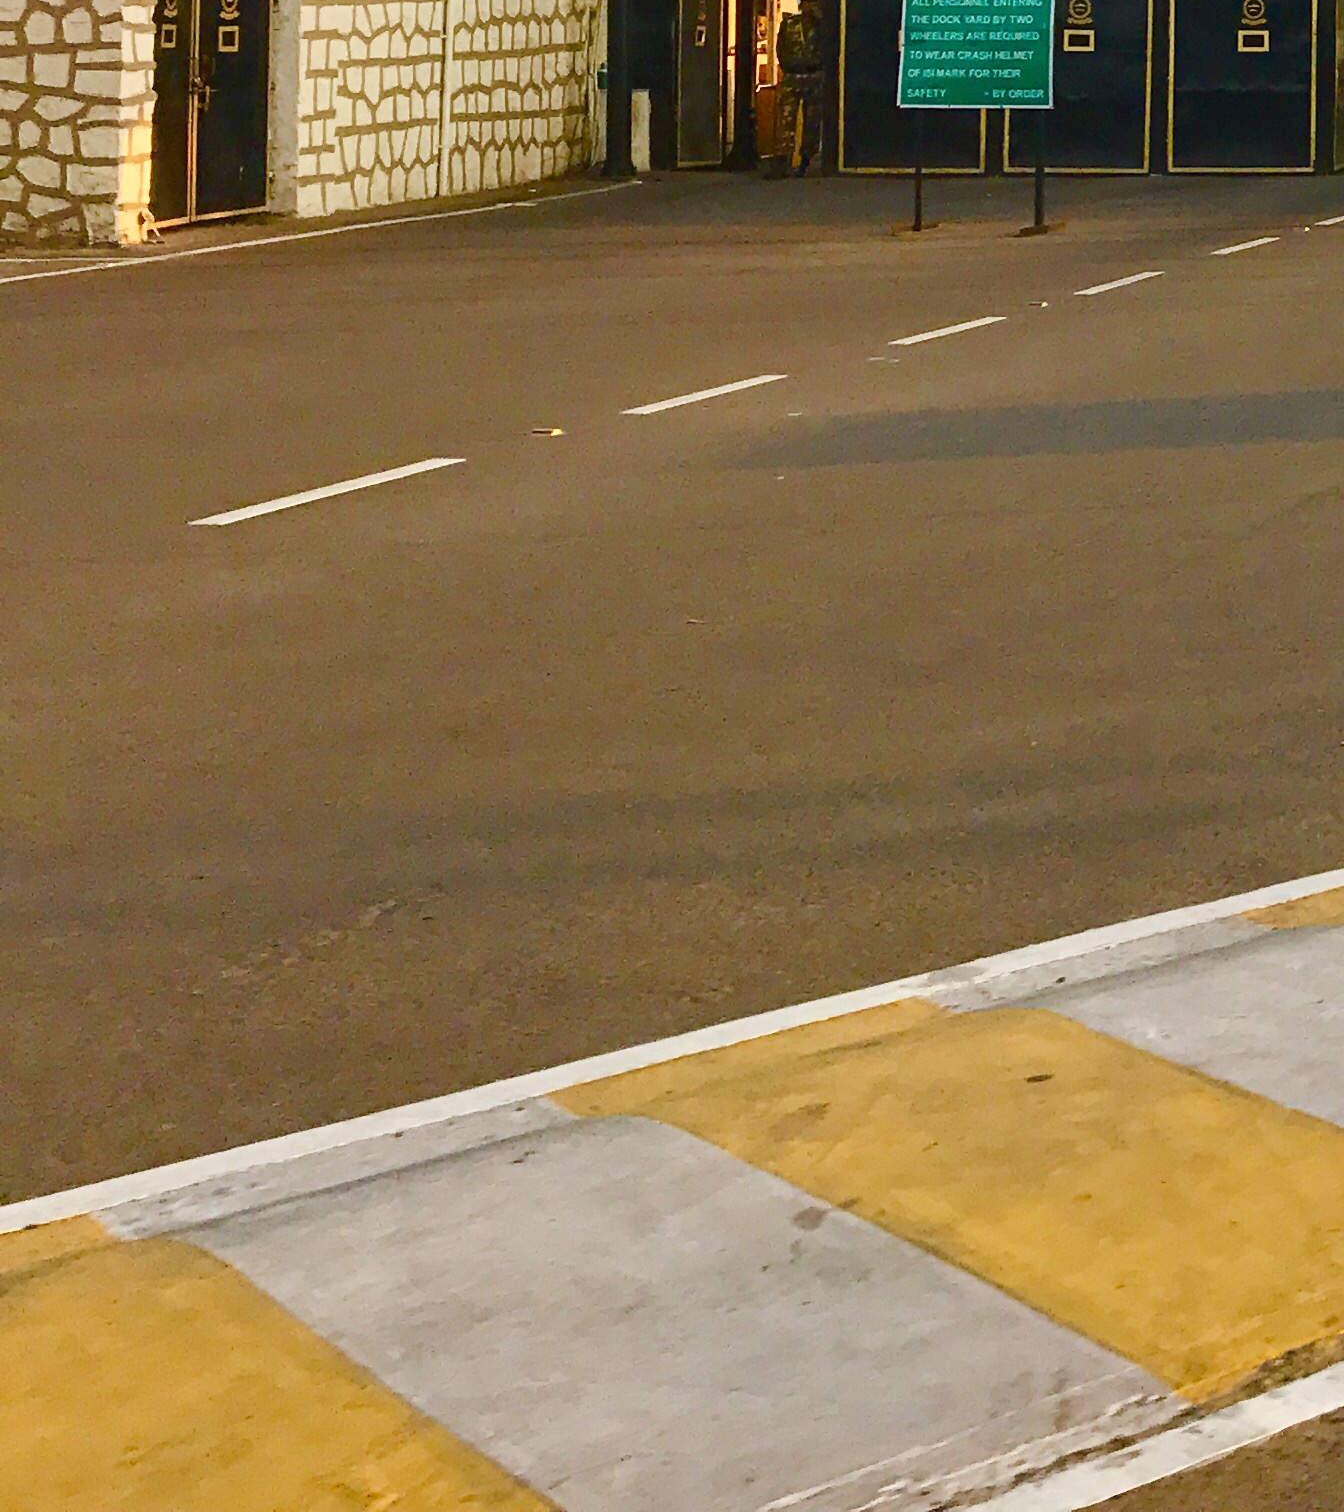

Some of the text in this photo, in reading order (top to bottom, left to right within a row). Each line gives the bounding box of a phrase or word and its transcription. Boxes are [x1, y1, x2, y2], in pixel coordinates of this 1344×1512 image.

[911, 14, 1034, 24] THE DOCK YARD BY TWO
[910, 31, 1040, 41] WHEELERS ARE REQUIRED
[909, 50, 1034, 60] TO WEAR CRASH HELMET
[907, 69, 920, 78] OF
[936, 69, 966, 78] MARK
[968, 69, 990, 78] FOR
[992, 69, 1021, 78] THEIR
[907, 88, 947, 98] SAFETY
[992, 88, 1006, 98] BY
[1008, 88, 1044, 98] ORDER
